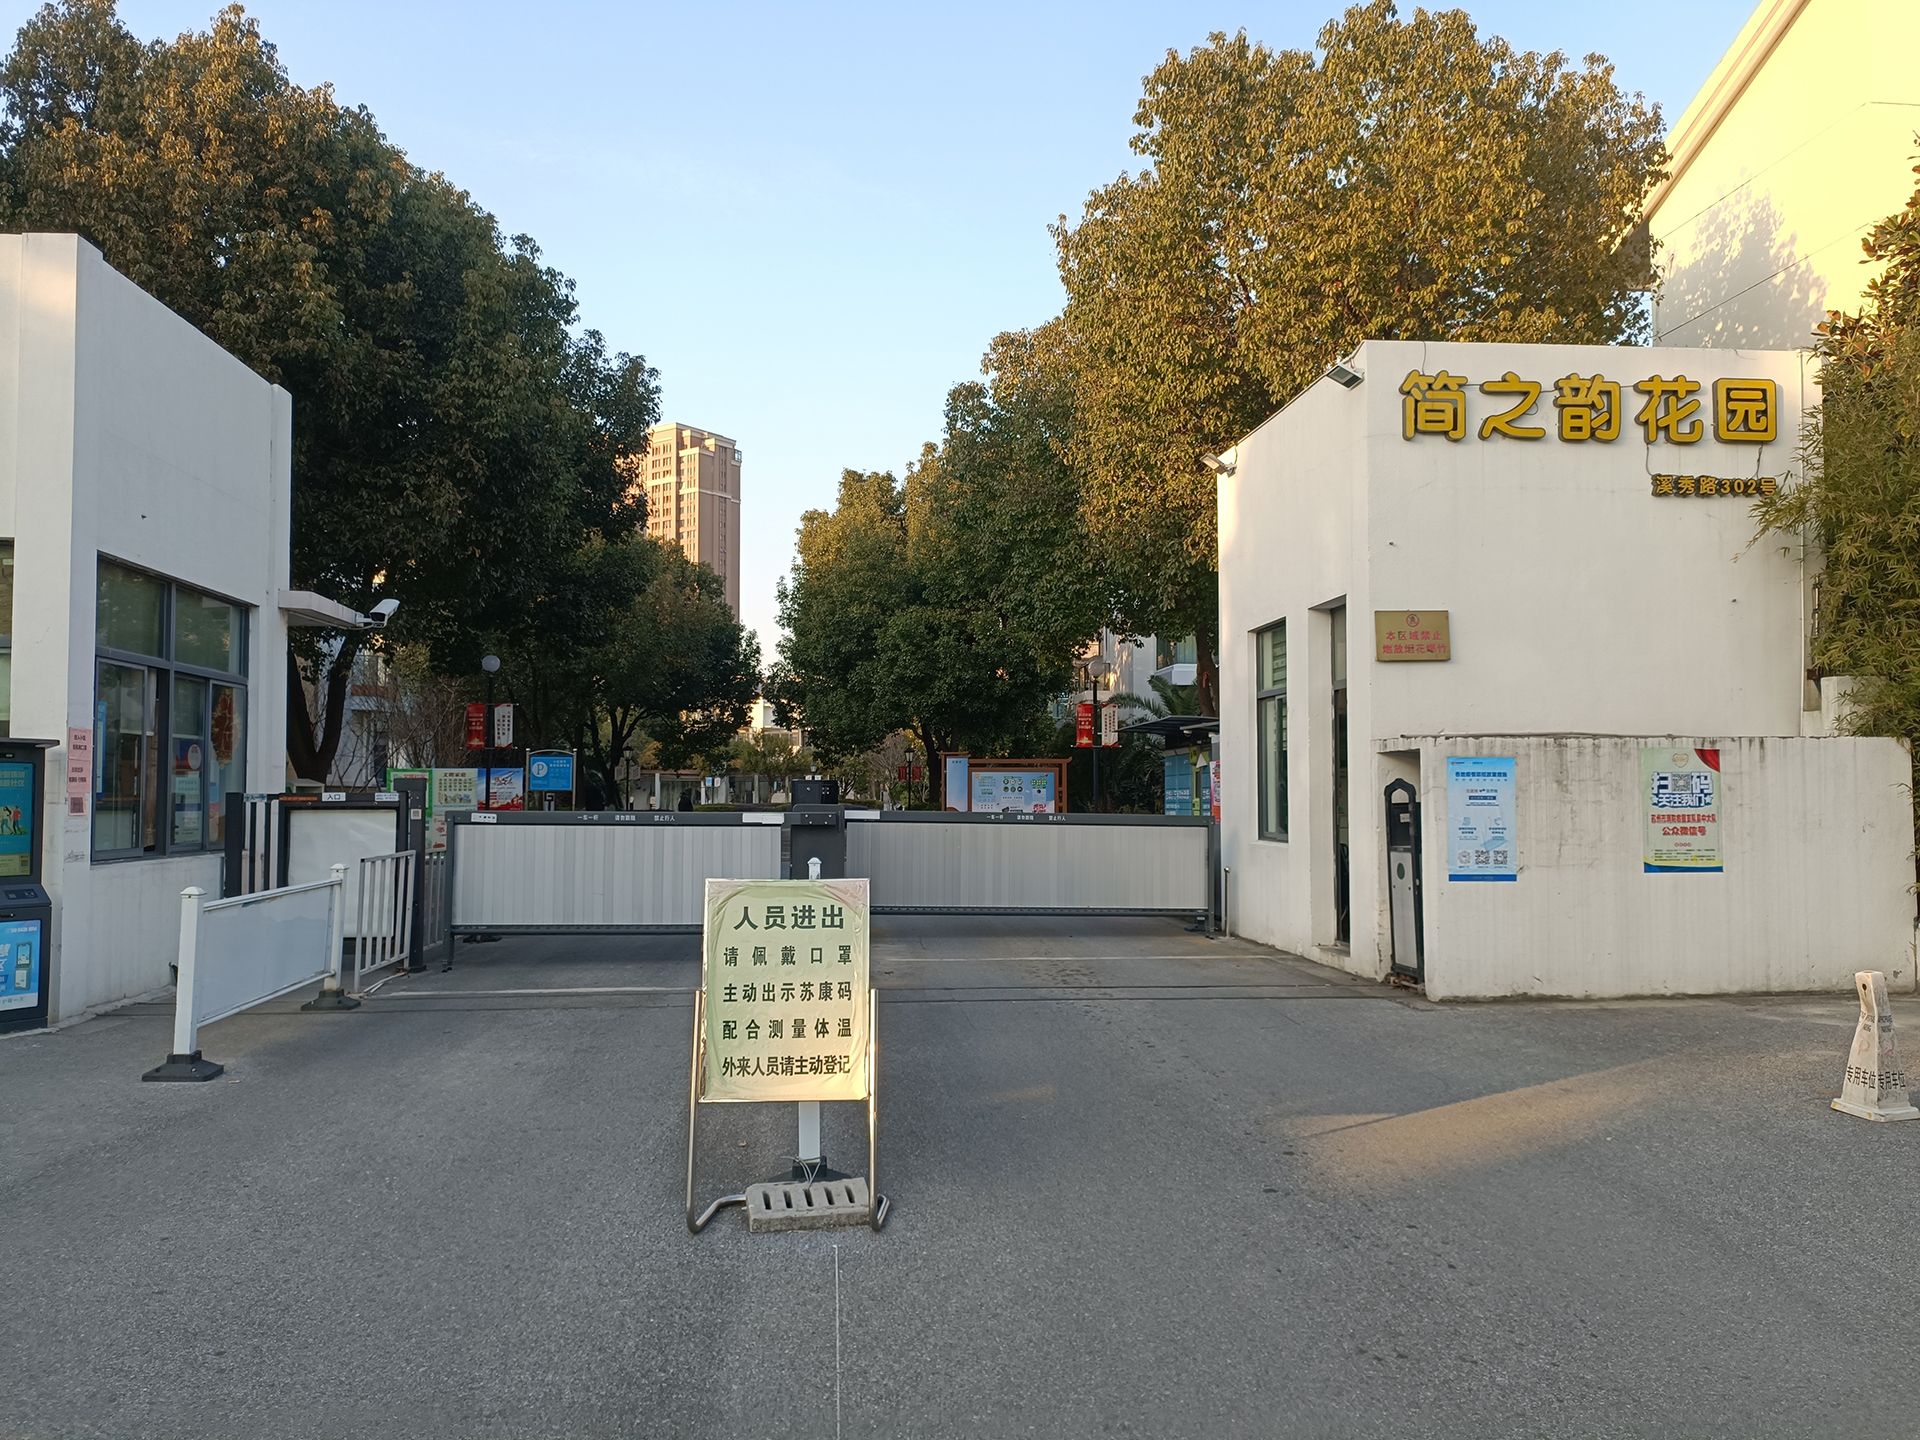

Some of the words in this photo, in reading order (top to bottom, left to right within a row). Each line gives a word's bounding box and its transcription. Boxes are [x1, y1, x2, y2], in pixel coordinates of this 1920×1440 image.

[1400, 369, 1777, 443] 简之韵花园
[1654, 474, 1777, 497] 溪秀路302号
[1658, 794, 1705, 807] 关注我们
[1662, 826, 1707, 836] 公众微信号
[733, 904, 844, 930] 人员进出
[723, 945, 852, 967] 请佩戴口罩
[723, 981, 852, 1002] 主动出示苏康码
[722, 1018, 852, 1040] 配合测量体温
[722, 1054, 850, 1077] 外来人员请主动登记
[1846, 1065, 1876, 1090] 专用车位
[1878, 1070, 1906, 1091] 专用车位
